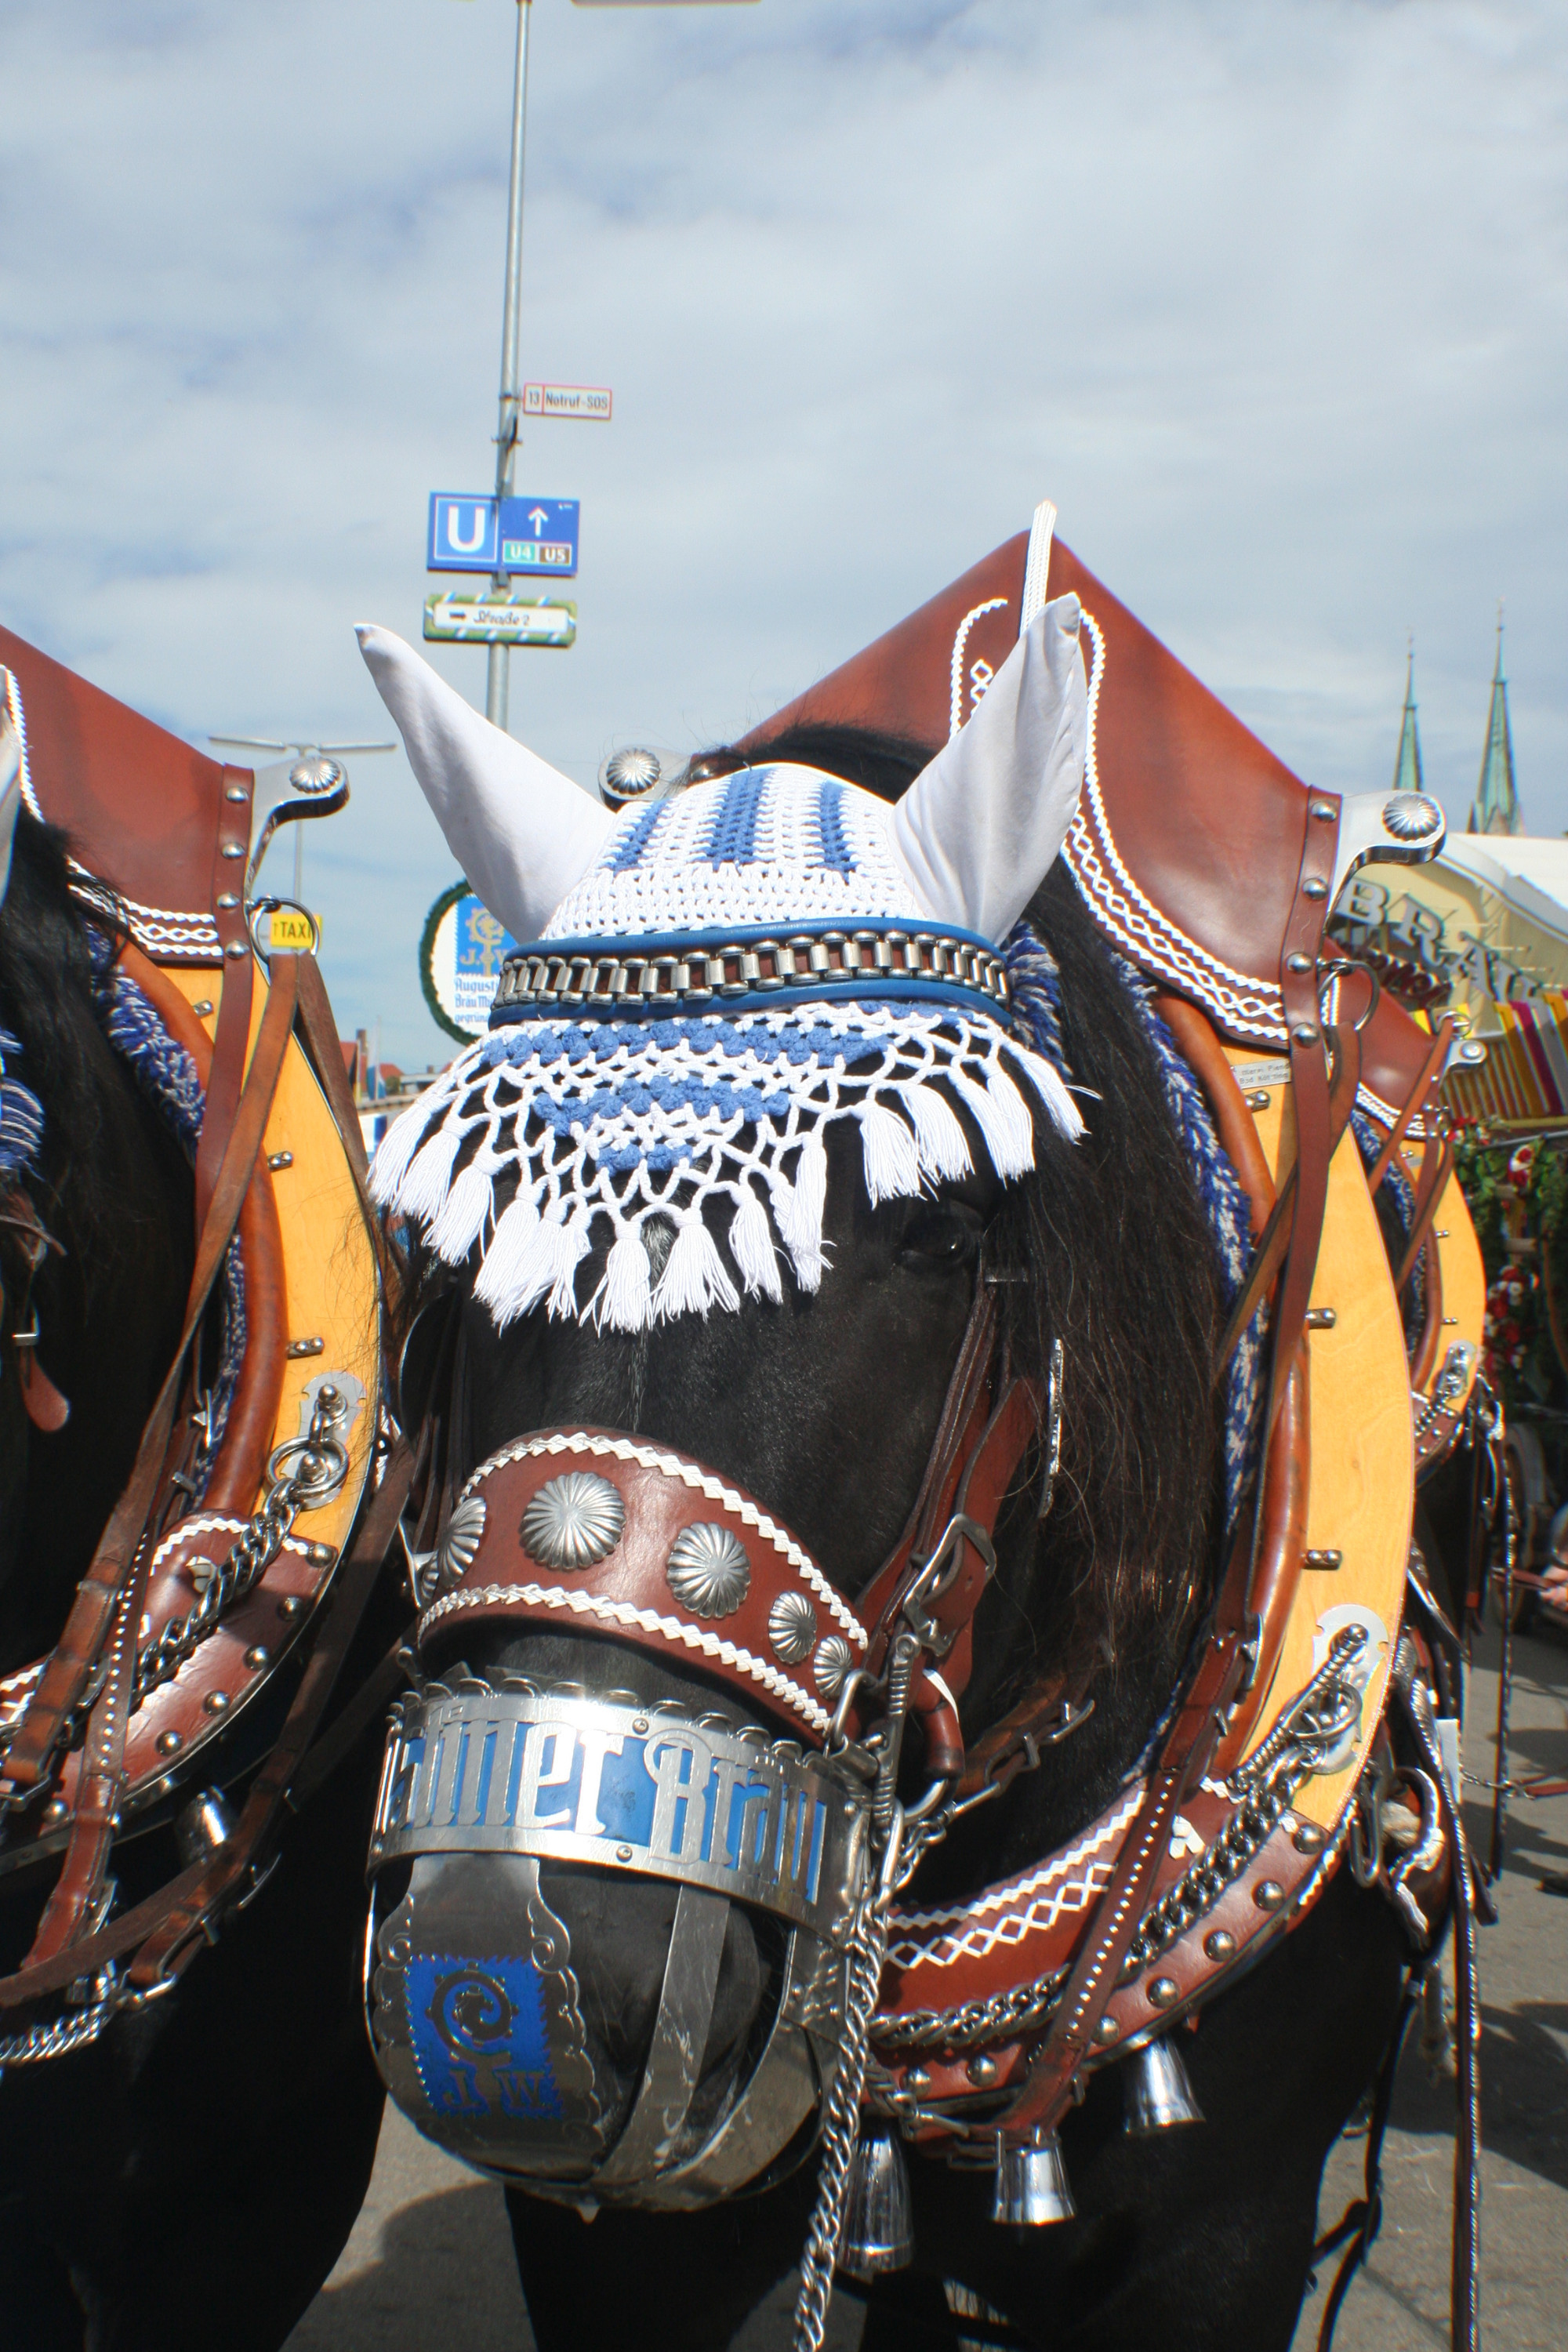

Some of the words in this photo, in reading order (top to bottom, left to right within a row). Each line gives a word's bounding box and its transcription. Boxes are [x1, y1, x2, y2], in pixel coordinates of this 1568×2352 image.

[529, 389, 539, 405] 13
[447, 505, 485, 554] U
[510, 543, 532, 561] U4
[544, 546, 566, 563] U5
[279, 920, 312, 939] TAXI
[644, 1727, 826, 1905] Bräu
